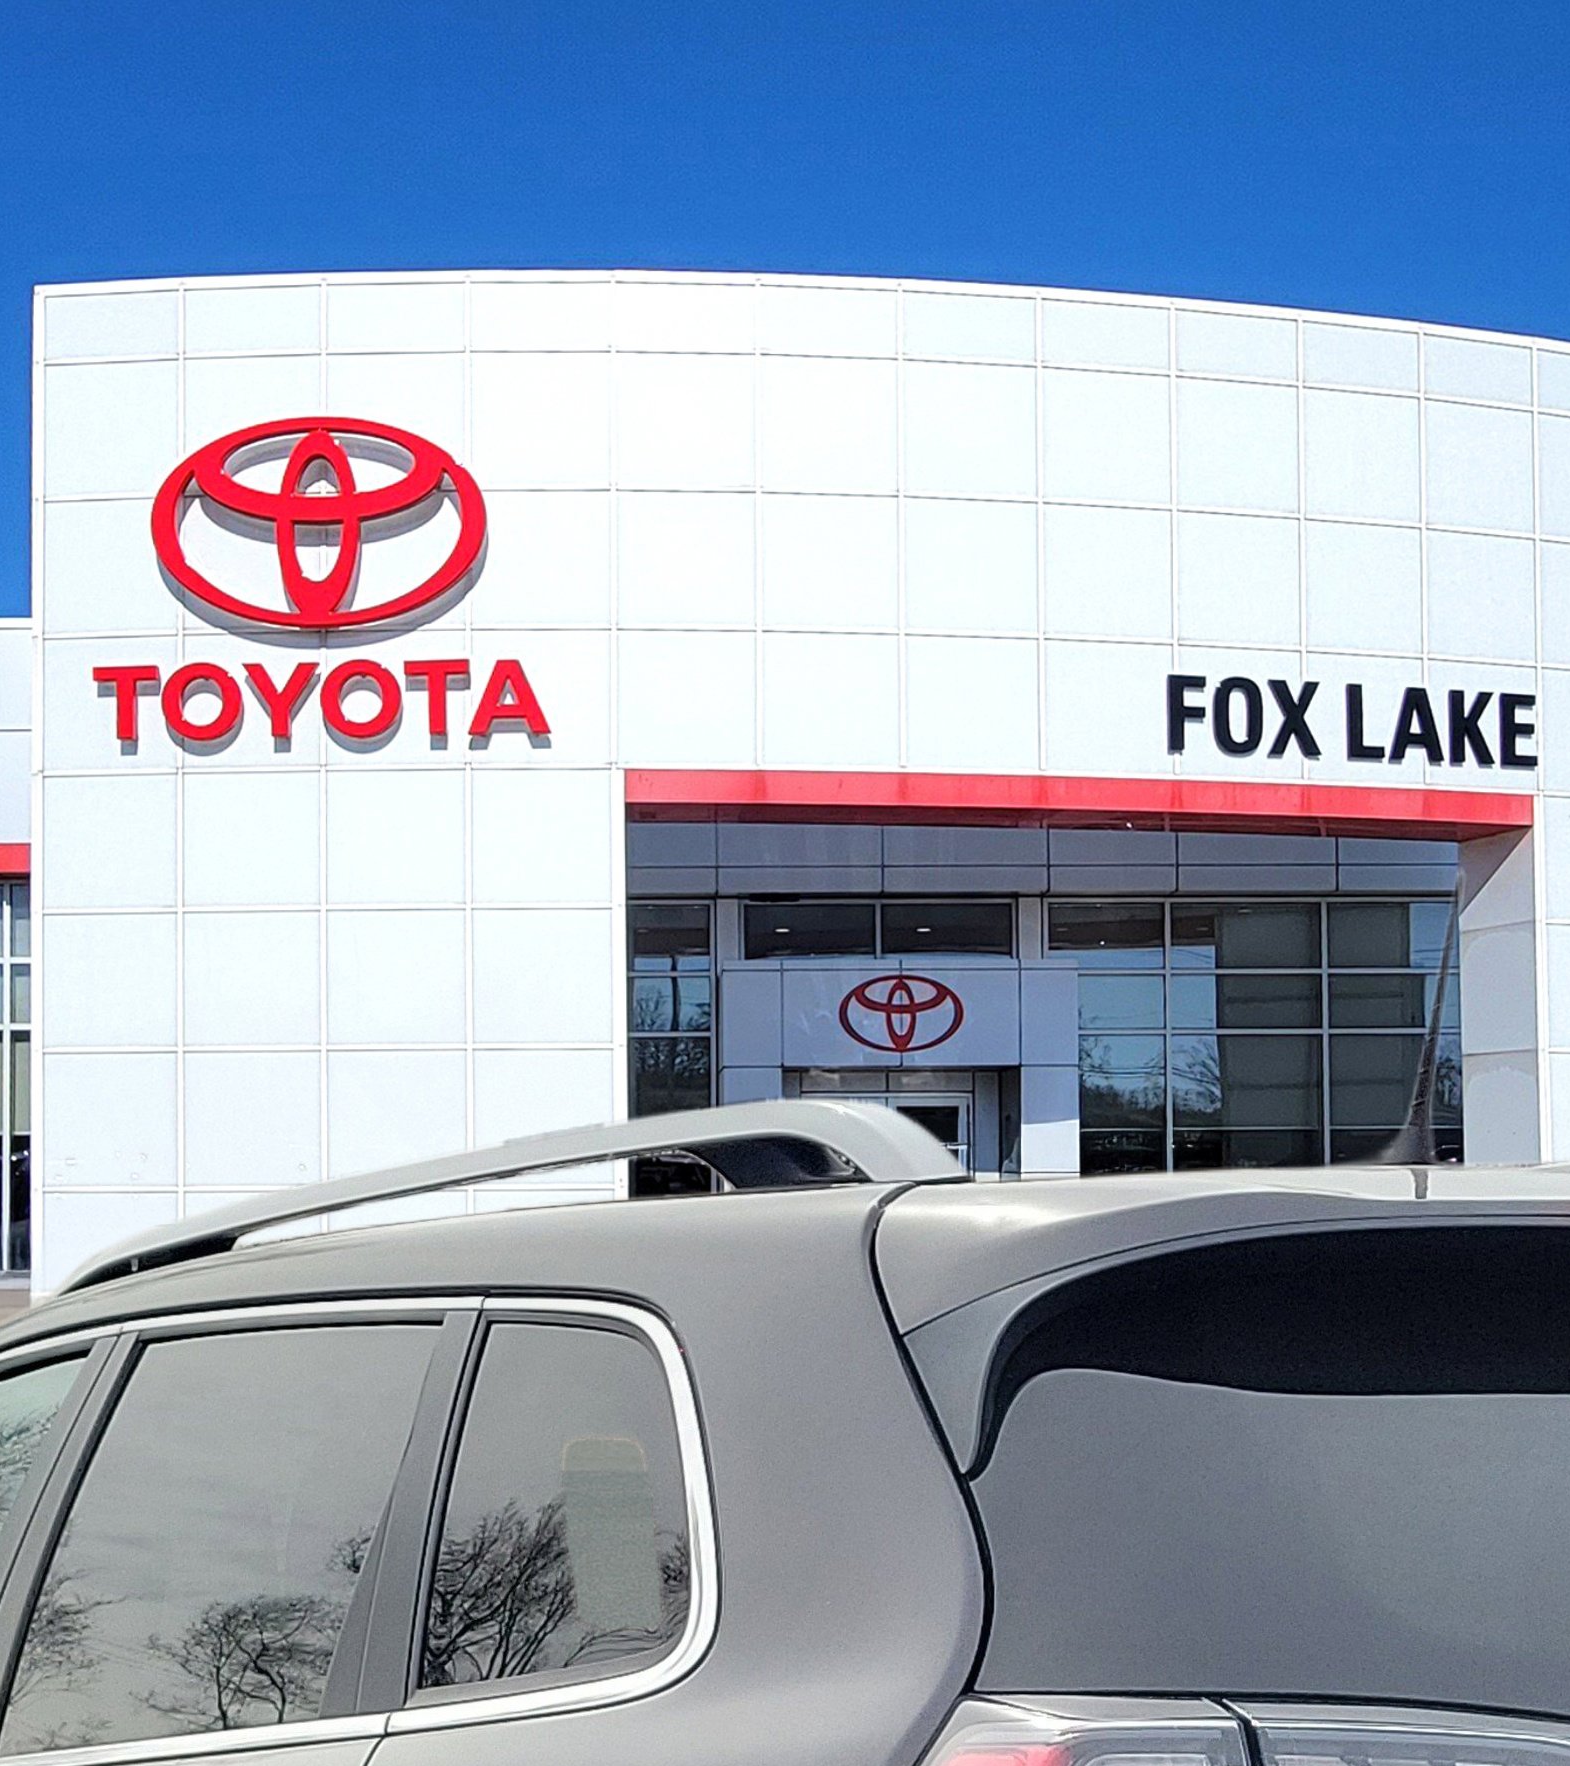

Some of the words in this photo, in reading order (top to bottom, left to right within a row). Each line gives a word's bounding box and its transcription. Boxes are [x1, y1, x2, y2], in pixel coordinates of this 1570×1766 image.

[92, 659, 552, 753] TOYOTA
[1167, 674, 1322, 760] FOX
[1345, 683, 1538, 771] LAKE
